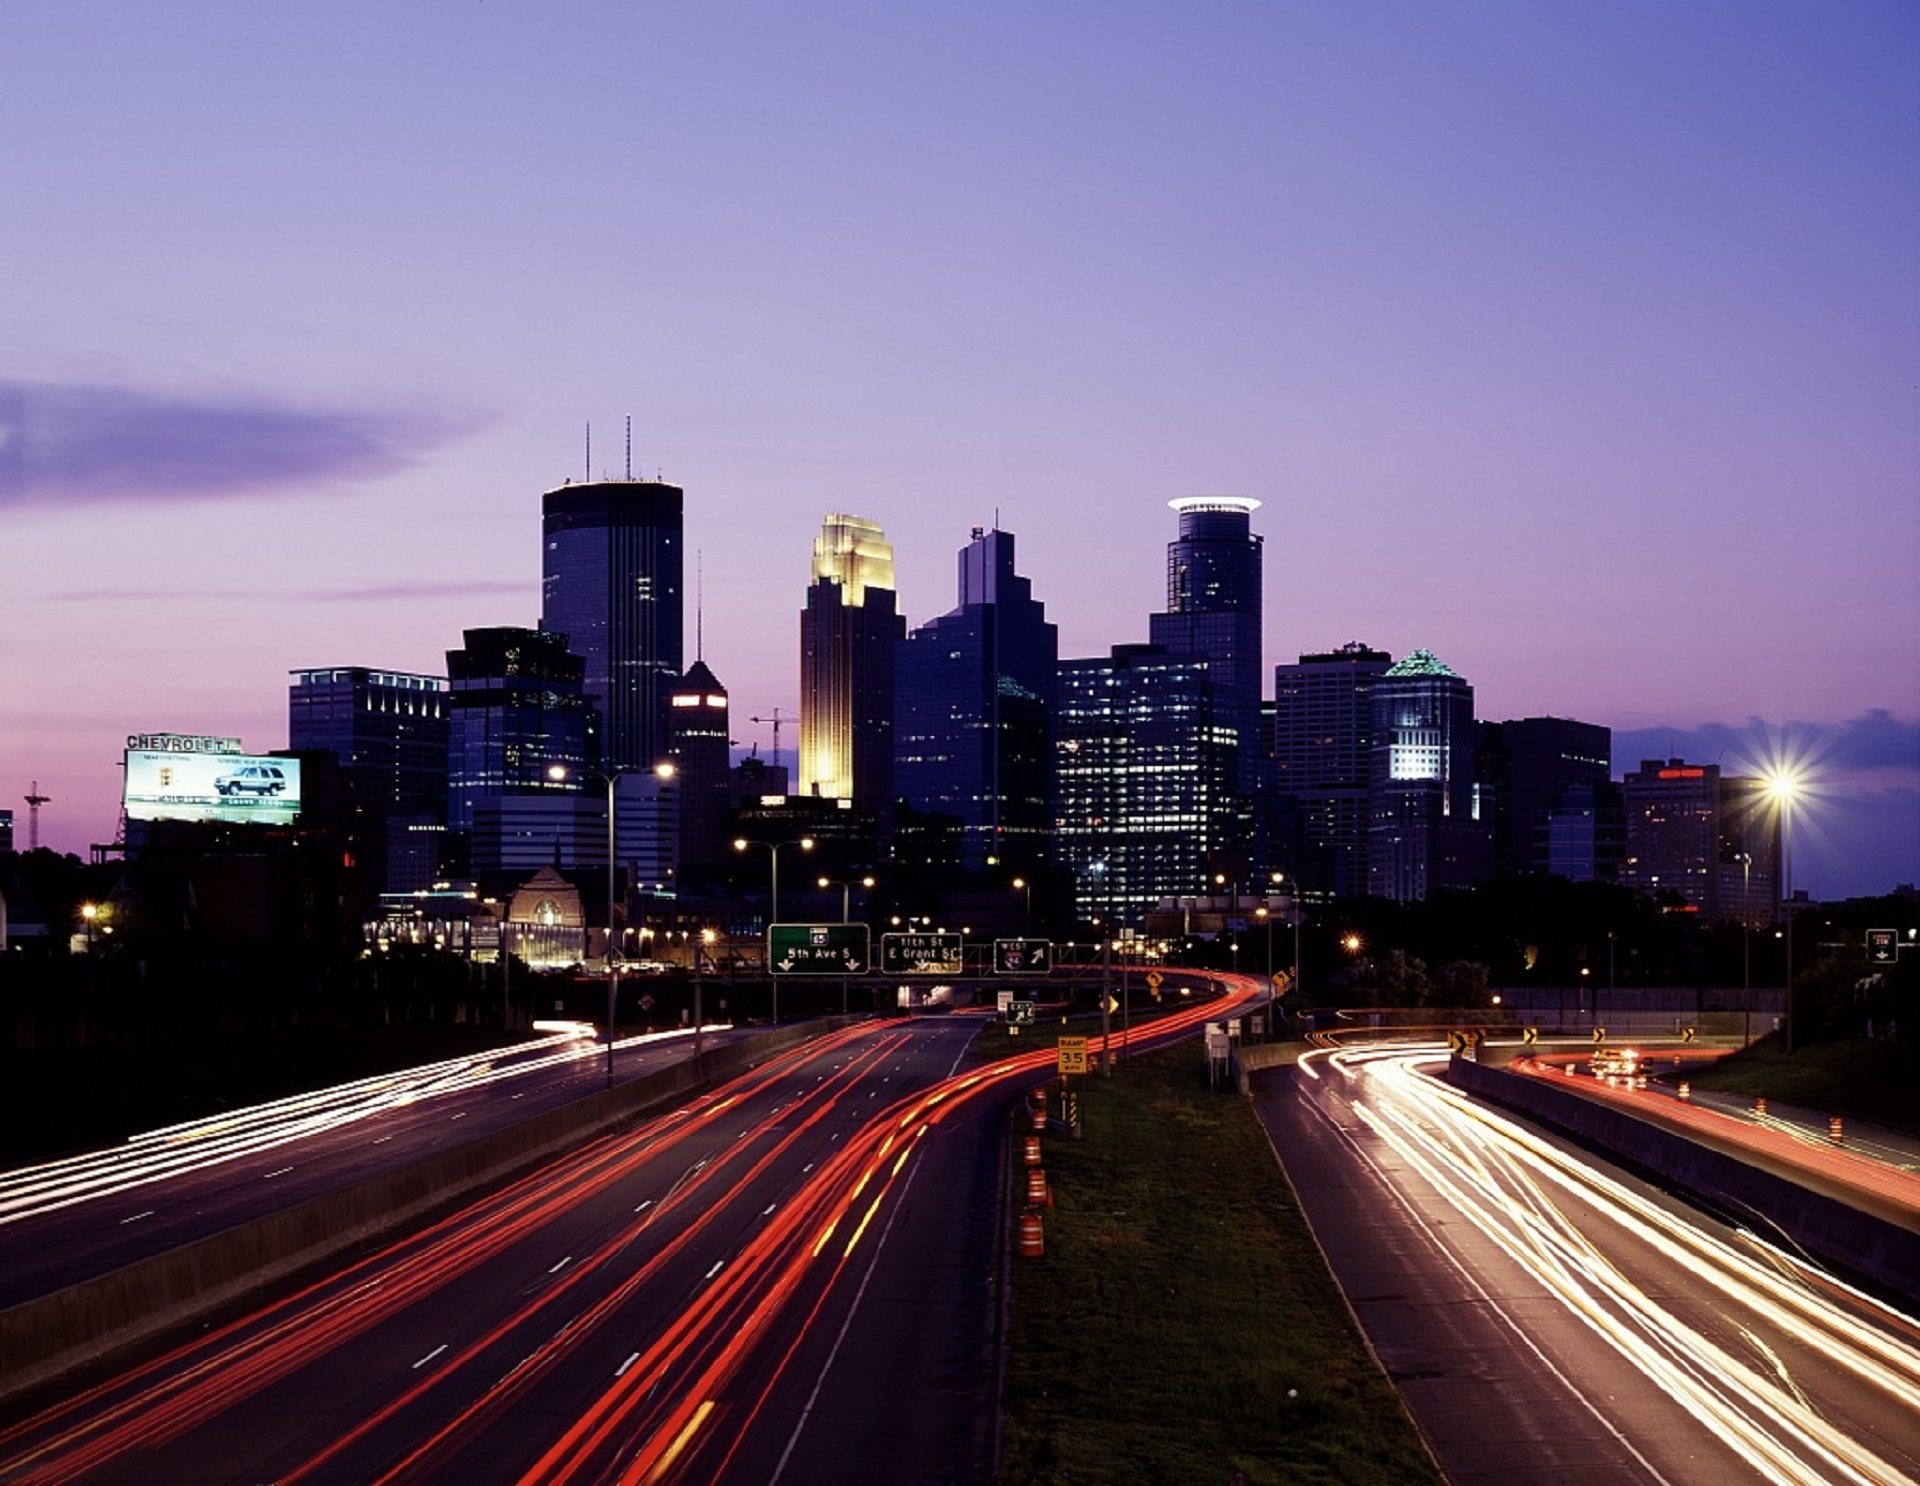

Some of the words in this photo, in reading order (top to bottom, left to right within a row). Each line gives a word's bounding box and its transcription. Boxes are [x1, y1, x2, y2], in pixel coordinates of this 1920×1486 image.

[127, 735, 223, 751] CHEVROLET
[901, 937, 925, 946] 11th
[930, 937, 943, 946] St
[788, 947, 809, 959] 5th
[815, 947, 837, 959] Ave
[842, 947, 850, 959] S
[889, 948, 897, 959] E
[903, 948, 936, 959] Grant
[1062, 1052, 1083, 1063] 35
